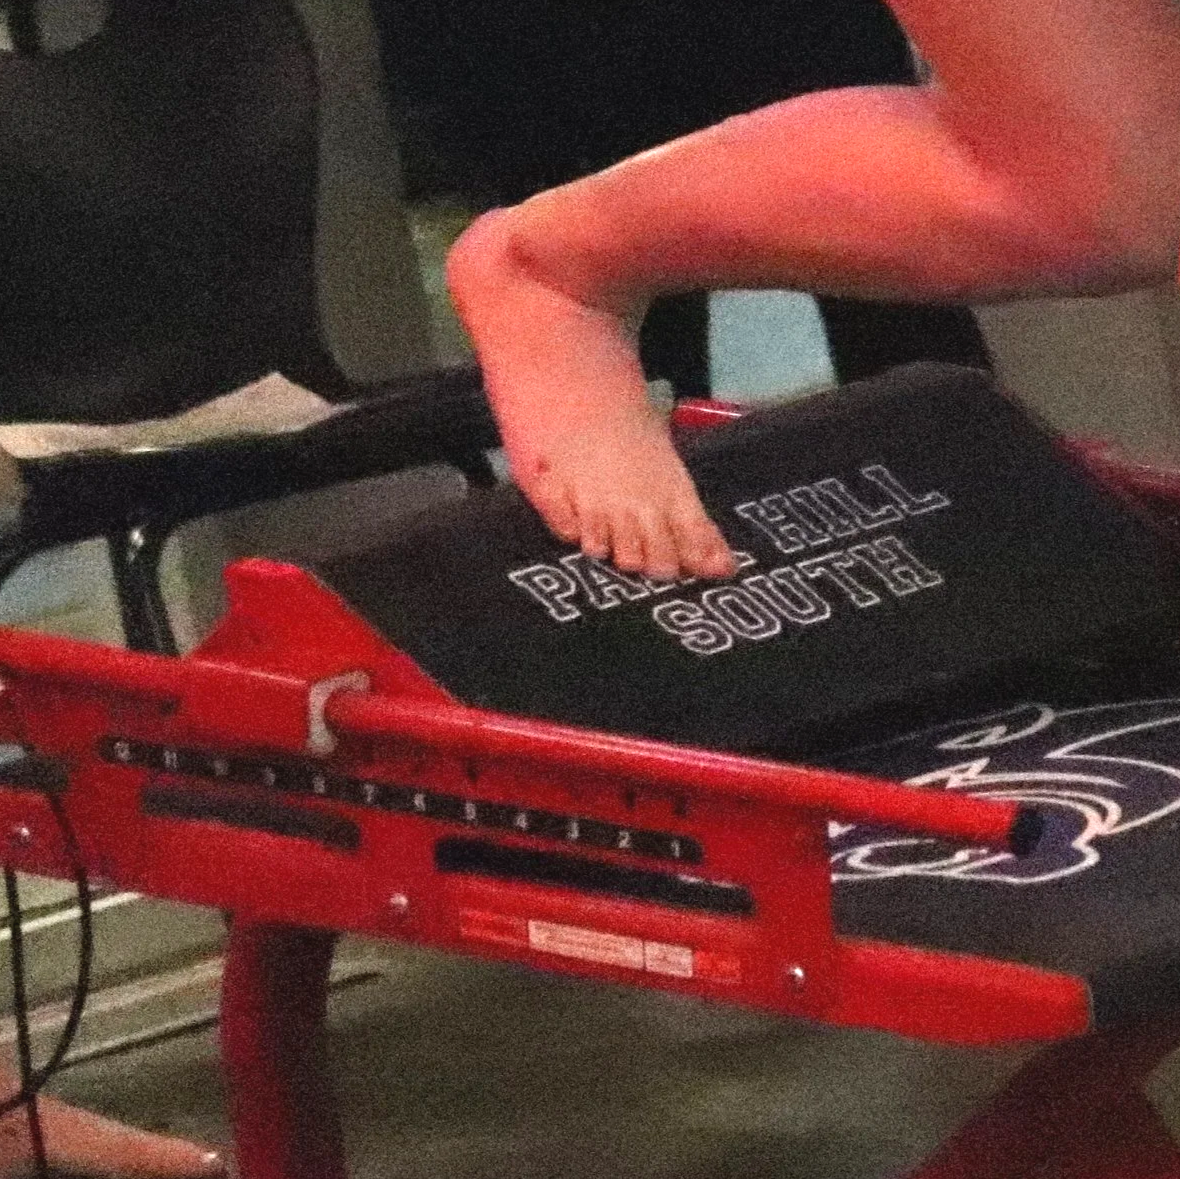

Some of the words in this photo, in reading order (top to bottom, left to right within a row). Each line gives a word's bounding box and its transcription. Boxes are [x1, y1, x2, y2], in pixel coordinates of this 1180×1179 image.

[509, 552, 756, 621] PA
[735, 464, 951, 553] HILL
[653, 536, 944, 655] SOUTH
[515, 811, 529, 831] 4
[617, 830, 631, 848] 2
[670, 840, 682, 858] 1
